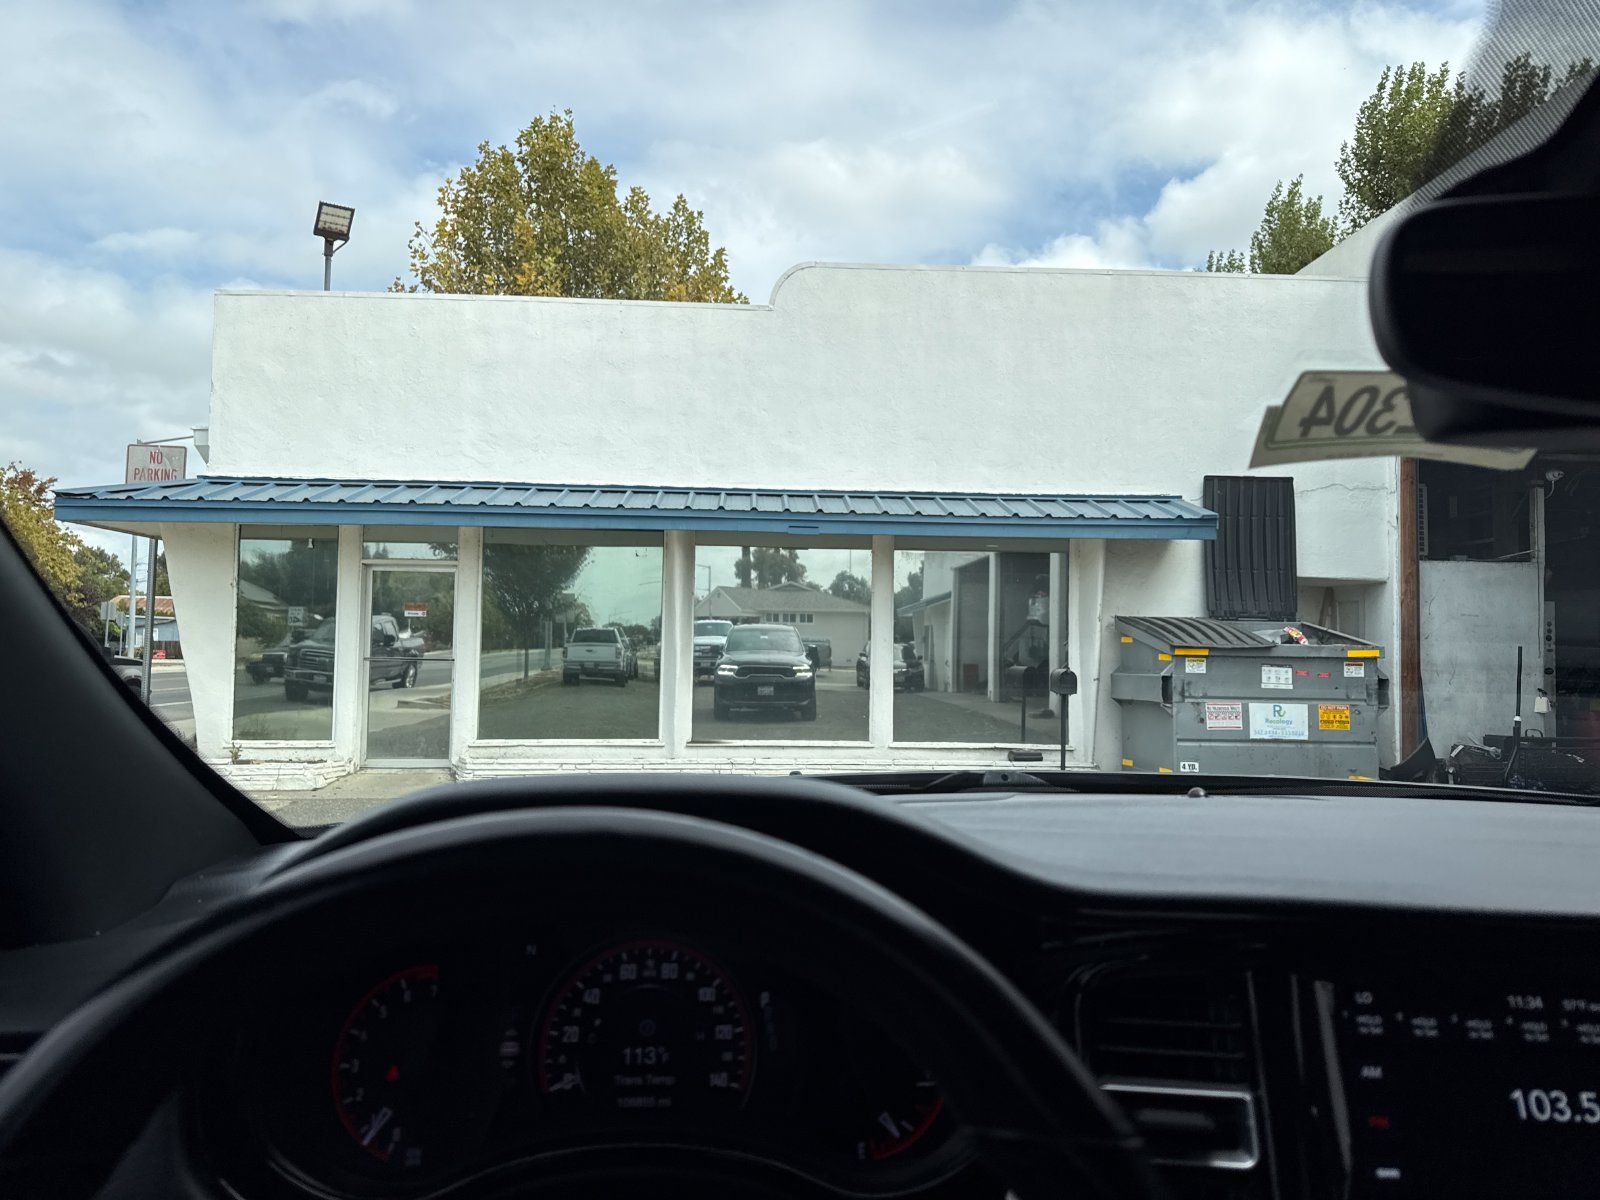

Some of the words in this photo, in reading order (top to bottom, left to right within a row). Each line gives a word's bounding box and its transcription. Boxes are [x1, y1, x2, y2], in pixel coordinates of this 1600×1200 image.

[149, 451, 163, 464] NO
[134, 467, 177, 481] PARKING
[562, 1025, 580, 1043] 20
[1509, 1088, 1600, 1124] 103.5
